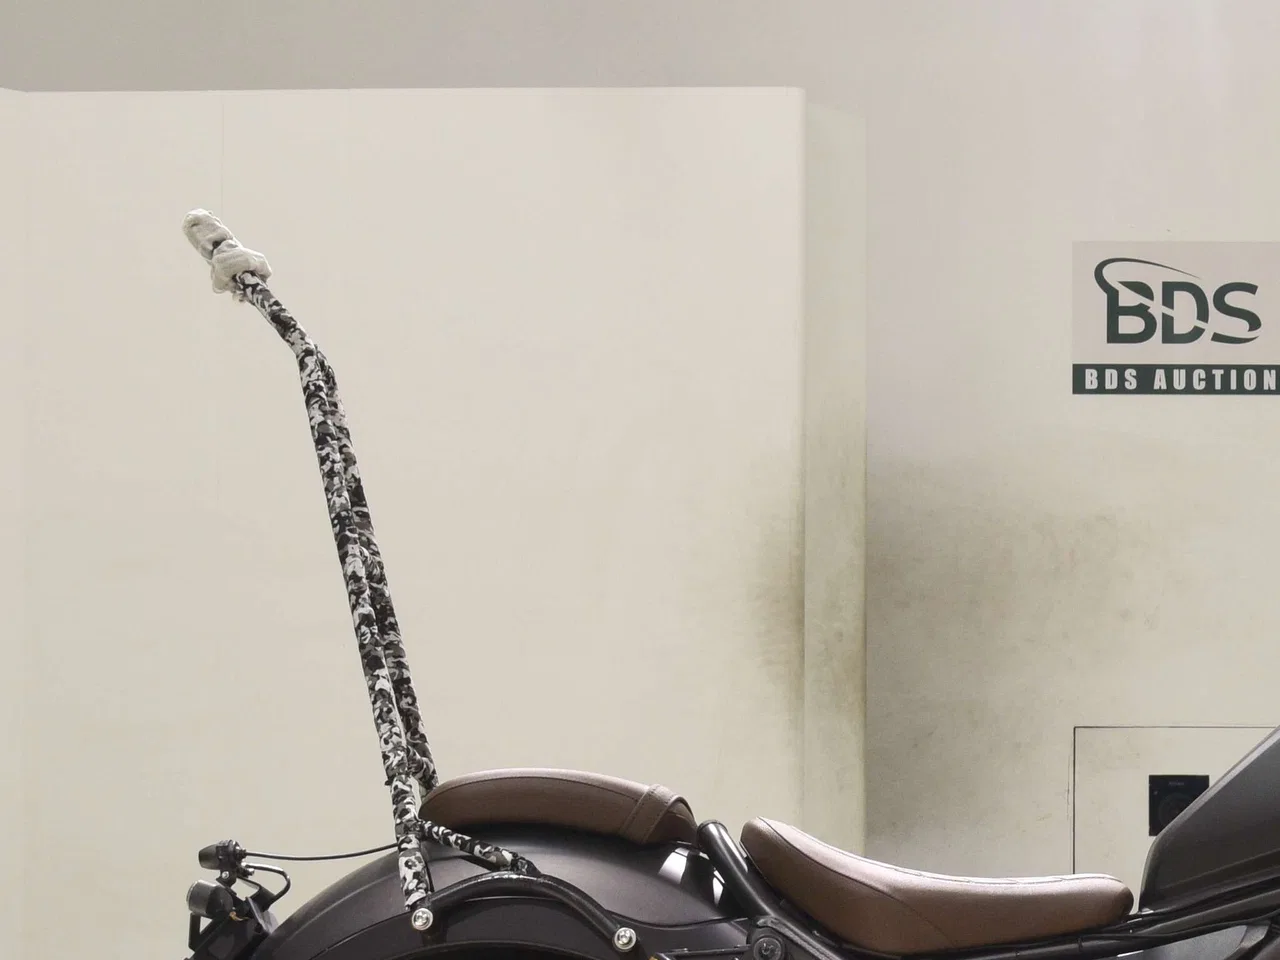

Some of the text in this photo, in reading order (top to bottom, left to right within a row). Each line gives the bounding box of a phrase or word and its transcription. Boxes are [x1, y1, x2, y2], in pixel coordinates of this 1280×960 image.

[1094, 257, 1262, 344] BDS
[1085, 368, 1277, 391] BDS AUCTION
